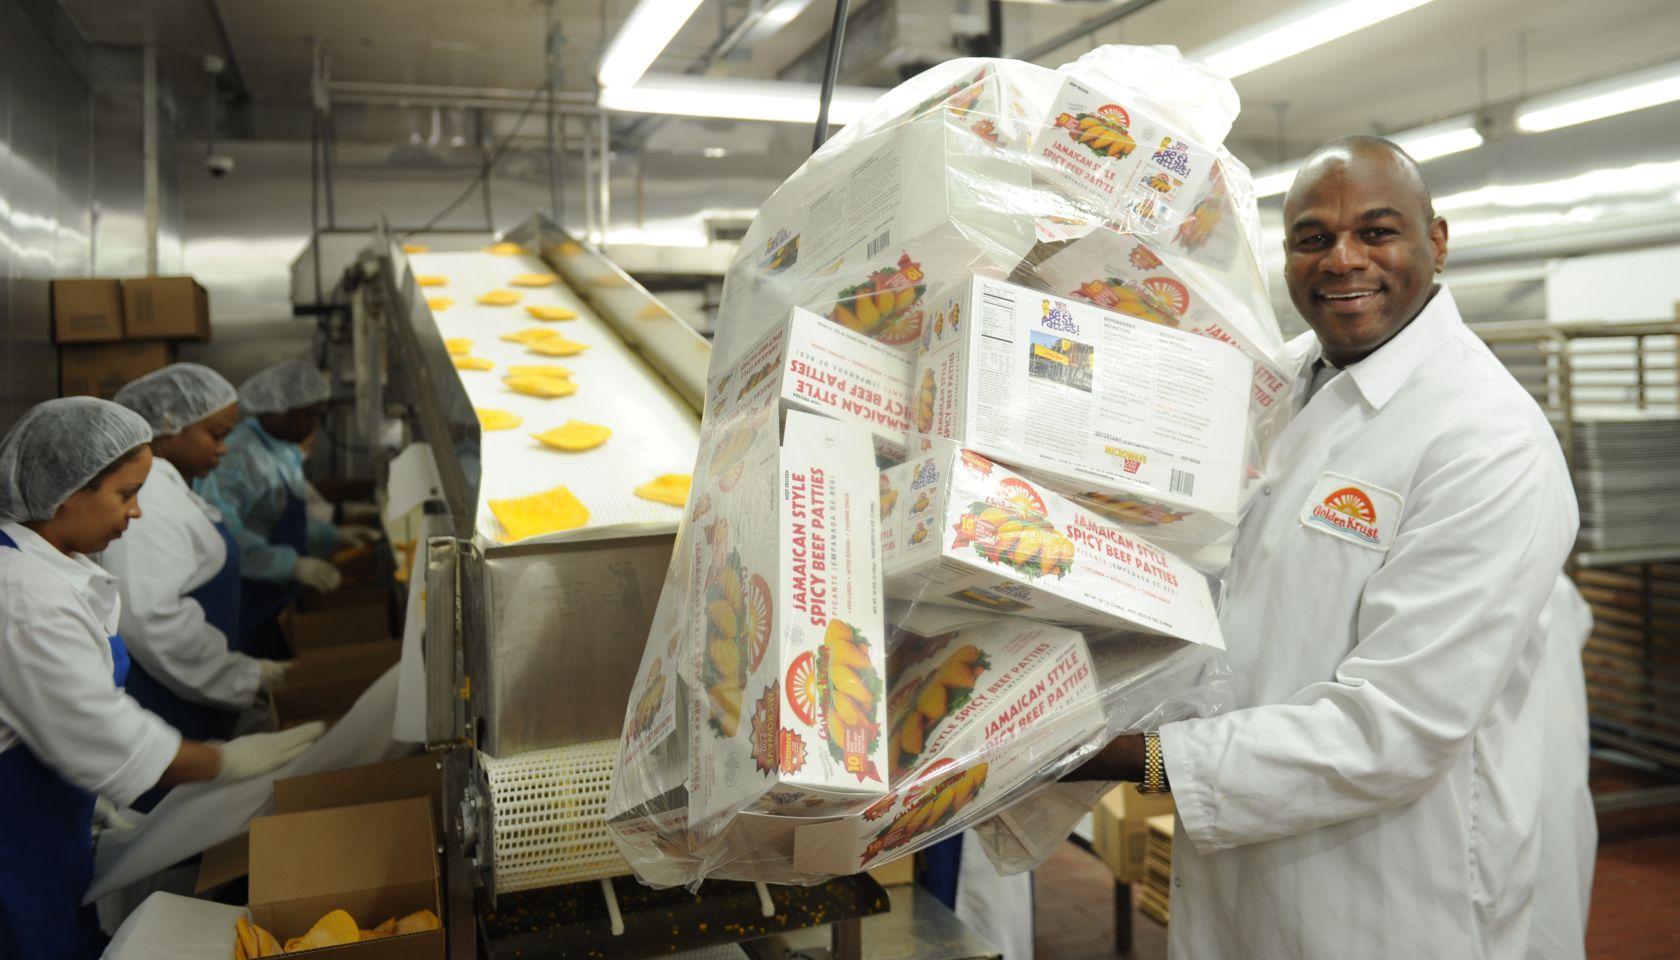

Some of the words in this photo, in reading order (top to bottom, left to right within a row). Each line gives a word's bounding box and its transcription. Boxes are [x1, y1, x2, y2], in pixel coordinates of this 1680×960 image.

[1042, 148, 1066, 165] SPICY
[1052, 141, 1092, 168] JAMAICAN
[1093, 163, 1116, 180] SLE
[1042, 316, 1080, 336] Patties!
[790, 360, 846, 392] PATTIES
[796, 380, 838, 407] STYLE
[850, 384, 882, 406] BEEF
[1104, 444, 1148, 464] MICROWAVE
[792, 473, 806, 518] STYLE
[810, 467, 825, 529] PATTIES
[1074, 512, 1134, 551] JAMAICAN
[1136, 543, 1168, 568] STYLE
[1313, 505, 1346, 527] Golden
[1347, 516, 1378, 539] Krust
[792, 523, 806, 612] JAMAICAN
[812, 533, 825, 571] BEEF
[1066, 525, 1102, 552] SPICY
[1106, 543, 1132, 565] BEEF
[1135, 557, 1179, 586] PATTIES
[810, 573, 826, 627] SPICY
[930, 722, 958, 753] STYLE
[955, 693, 987, 721] SPICY
[987, 674, 1012, 694] BEEF
[1011, 642, 1050, 674] PATTIES
[984, 680, 1046, 740] JAMAICAN
[1047, 651, 1079, 686] STYLE
[1018, 701, 1045, 729] BEEF
[1047, 663, 1089, 707] PATTIES
[848, 756, 860, 772] 10
